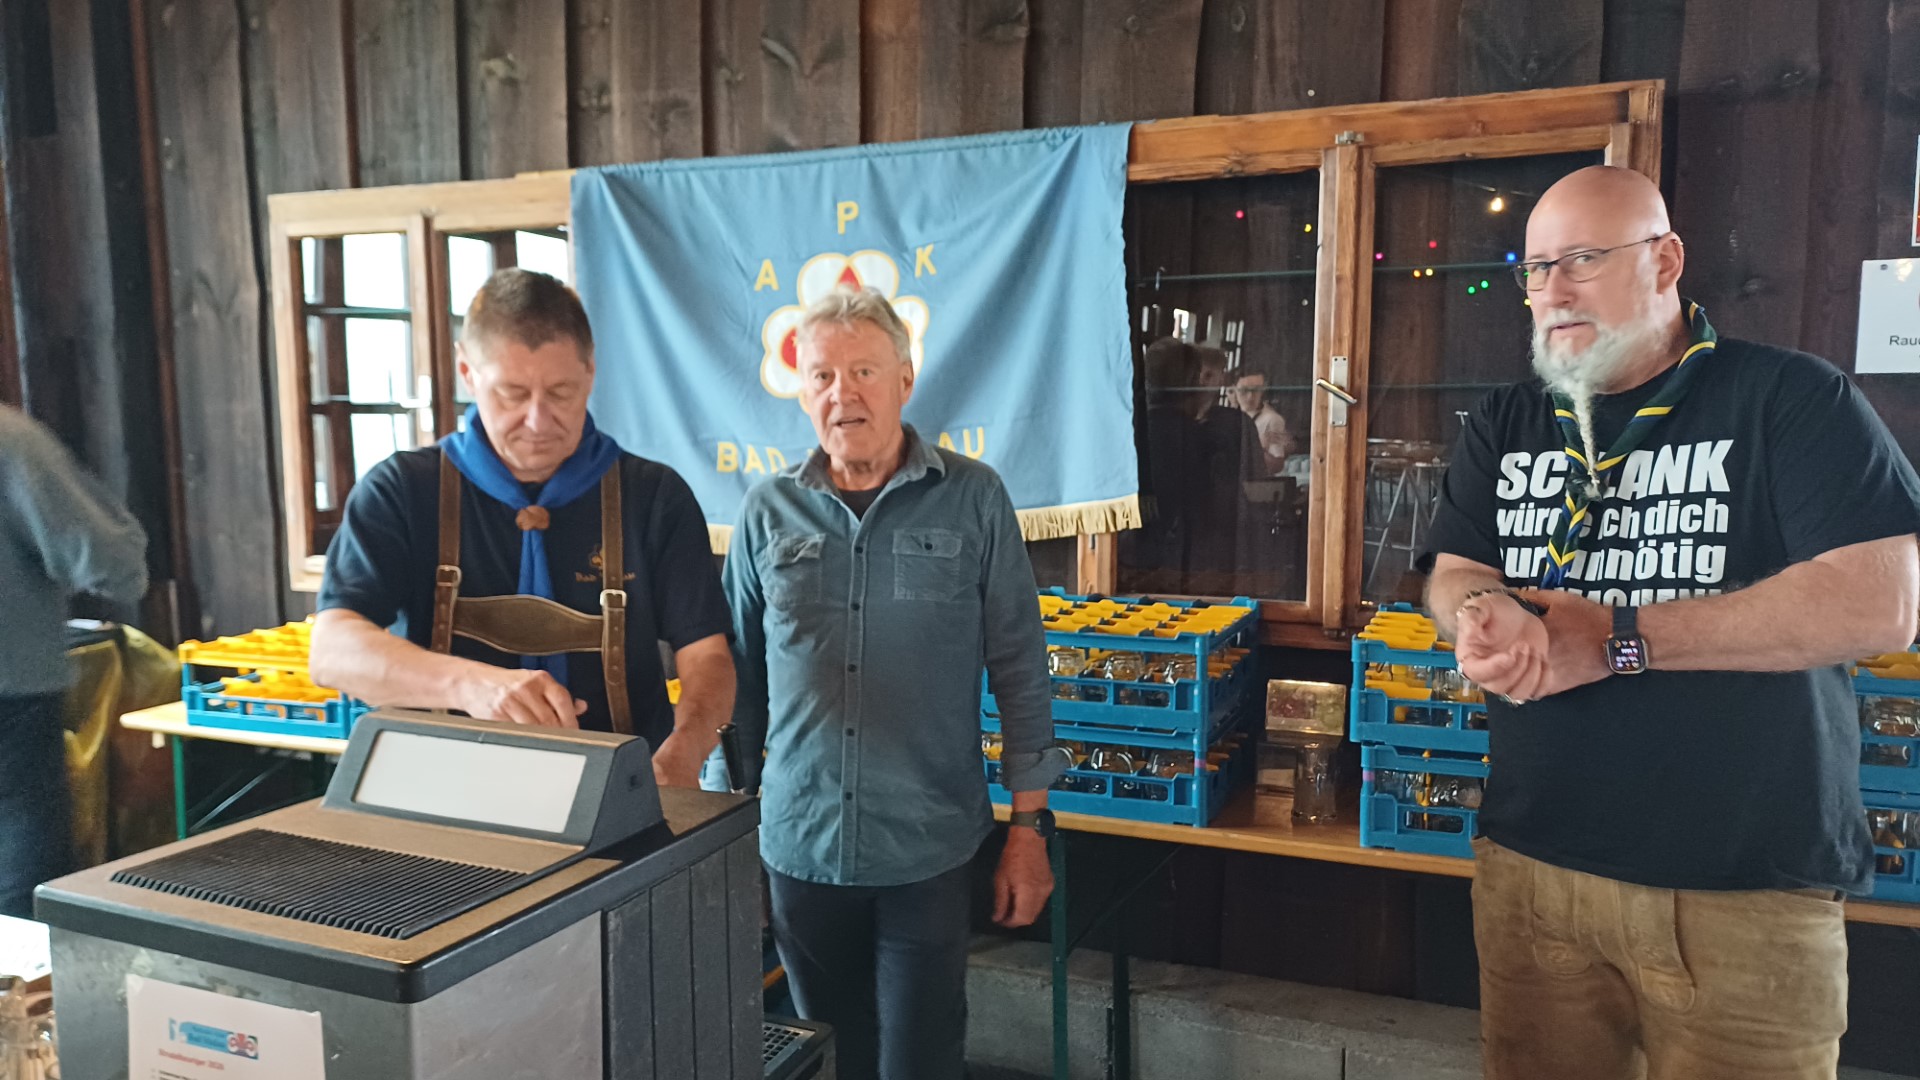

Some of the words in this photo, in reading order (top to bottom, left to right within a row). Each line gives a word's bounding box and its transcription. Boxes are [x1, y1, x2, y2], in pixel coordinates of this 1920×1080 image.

[754, 259, 779, 291] A
[837, 201, 859, 235] P
[915, 244, 937, 278] K
[1889, 335, 1920, 346] Rau
[716, 441, 788, 474] BAD
[1496, 439, 1734, 501] SCANK
[1643, 498, 1729, 536] dich
[1500, 541, 1549, 579] ur
